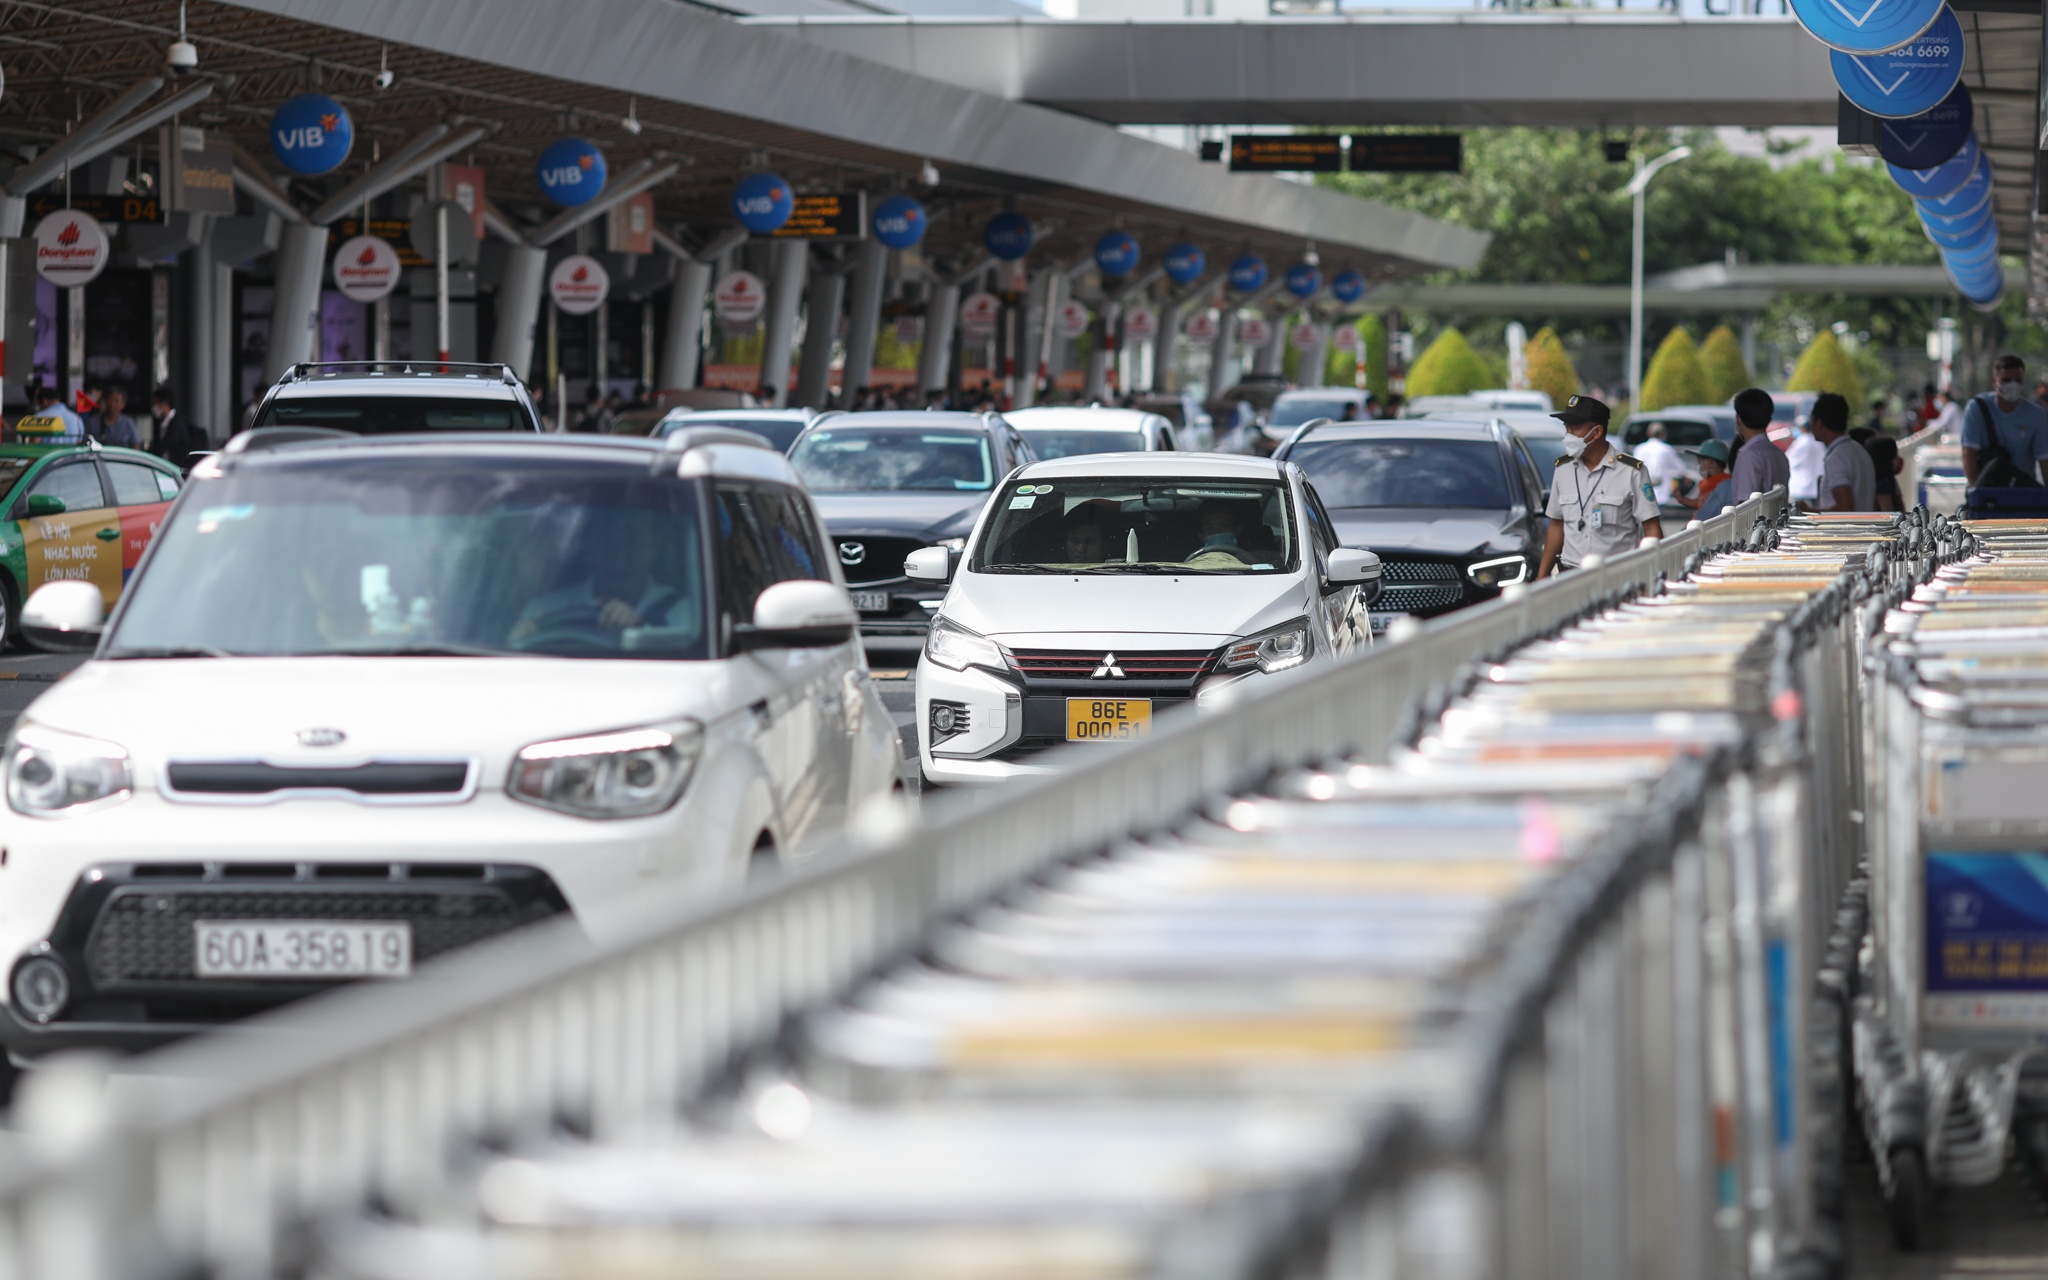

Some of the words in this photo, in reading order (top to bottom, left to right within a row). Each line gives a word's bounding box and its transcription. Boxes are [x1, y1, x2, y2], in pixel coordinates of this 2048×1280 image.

[1913, 37, 1949, 45] ERTISING
[1917, 46, 1949, 57] 6699
[1889, 61, 1949, 69] goldsungroup.com.vn
[278, 126, 324, 149] VIB
[542, 166, 583, 187] VIB
[124, 199, 156, 221] D4
[737, 197, 774, 215] VIB
[54, 521, 71, 541] HỘI
[44, 545, 70, 563] NHẠC
[71, 542, 98, 560] NƯỚC
[44, 563, 63, 582] LỚN
[65, 561, 90, 580] NHẤT
[1092, 702, 1127, 719] 86E
[1077, 721, 1140, 739] 000.51
[205, 931, 402, 969] 60A-358.19
